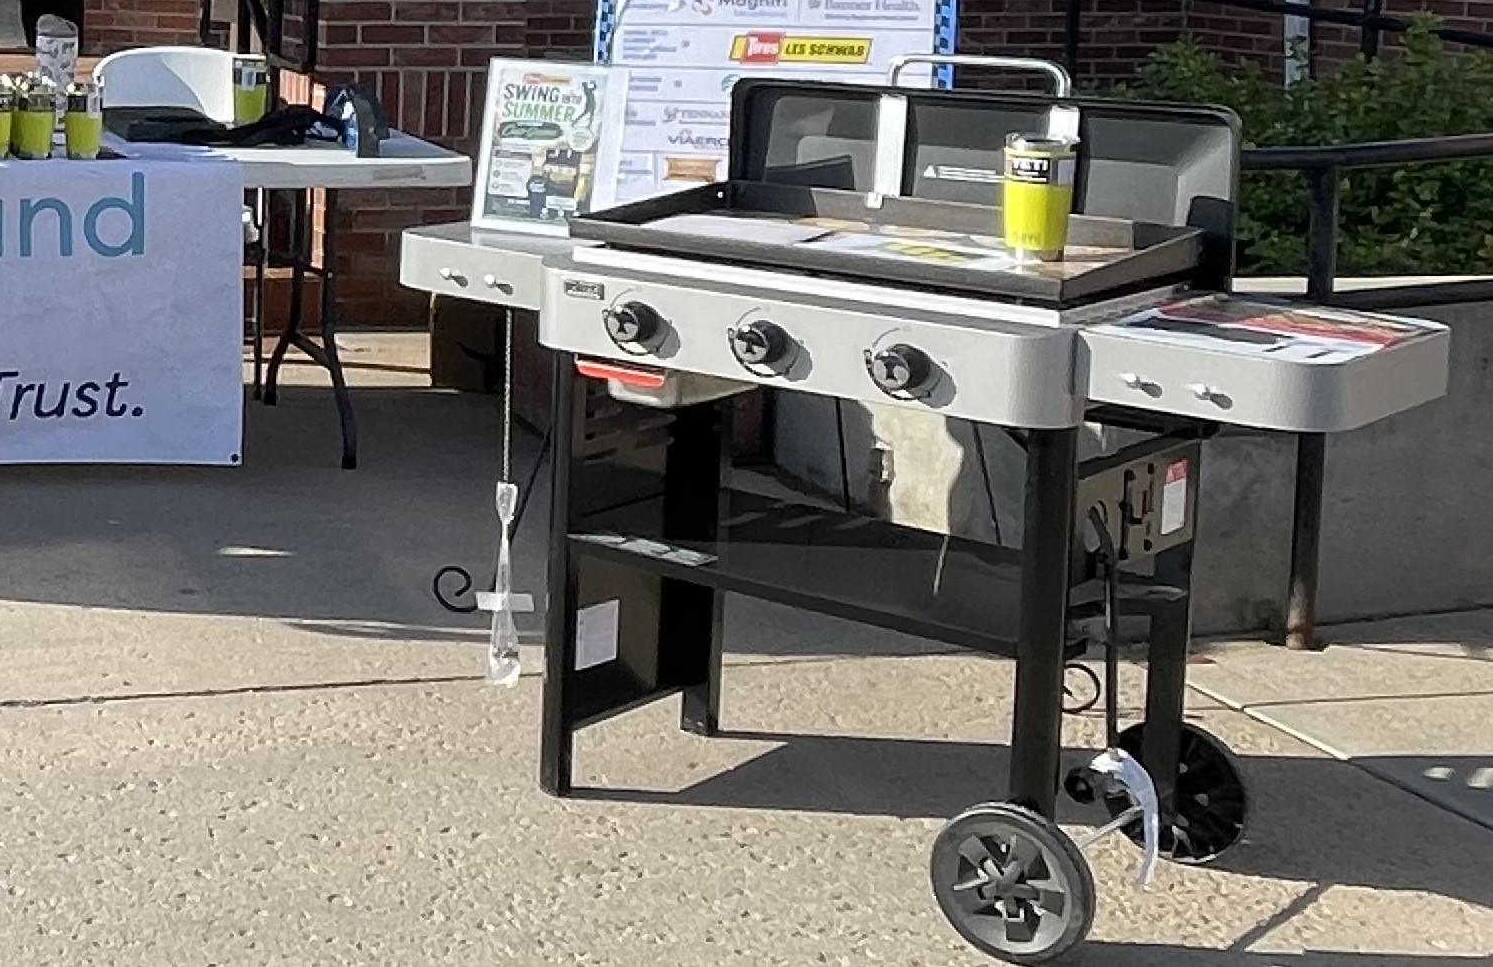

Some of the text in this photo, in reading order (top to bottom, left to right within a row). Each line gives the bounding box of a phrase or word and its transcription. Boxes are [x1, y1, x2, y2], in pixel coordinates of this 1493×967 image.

[785, 44, 806, 54] LES
[504, 83, 560, 102] SWING
[502, 102, 576, 122] SUMMER
